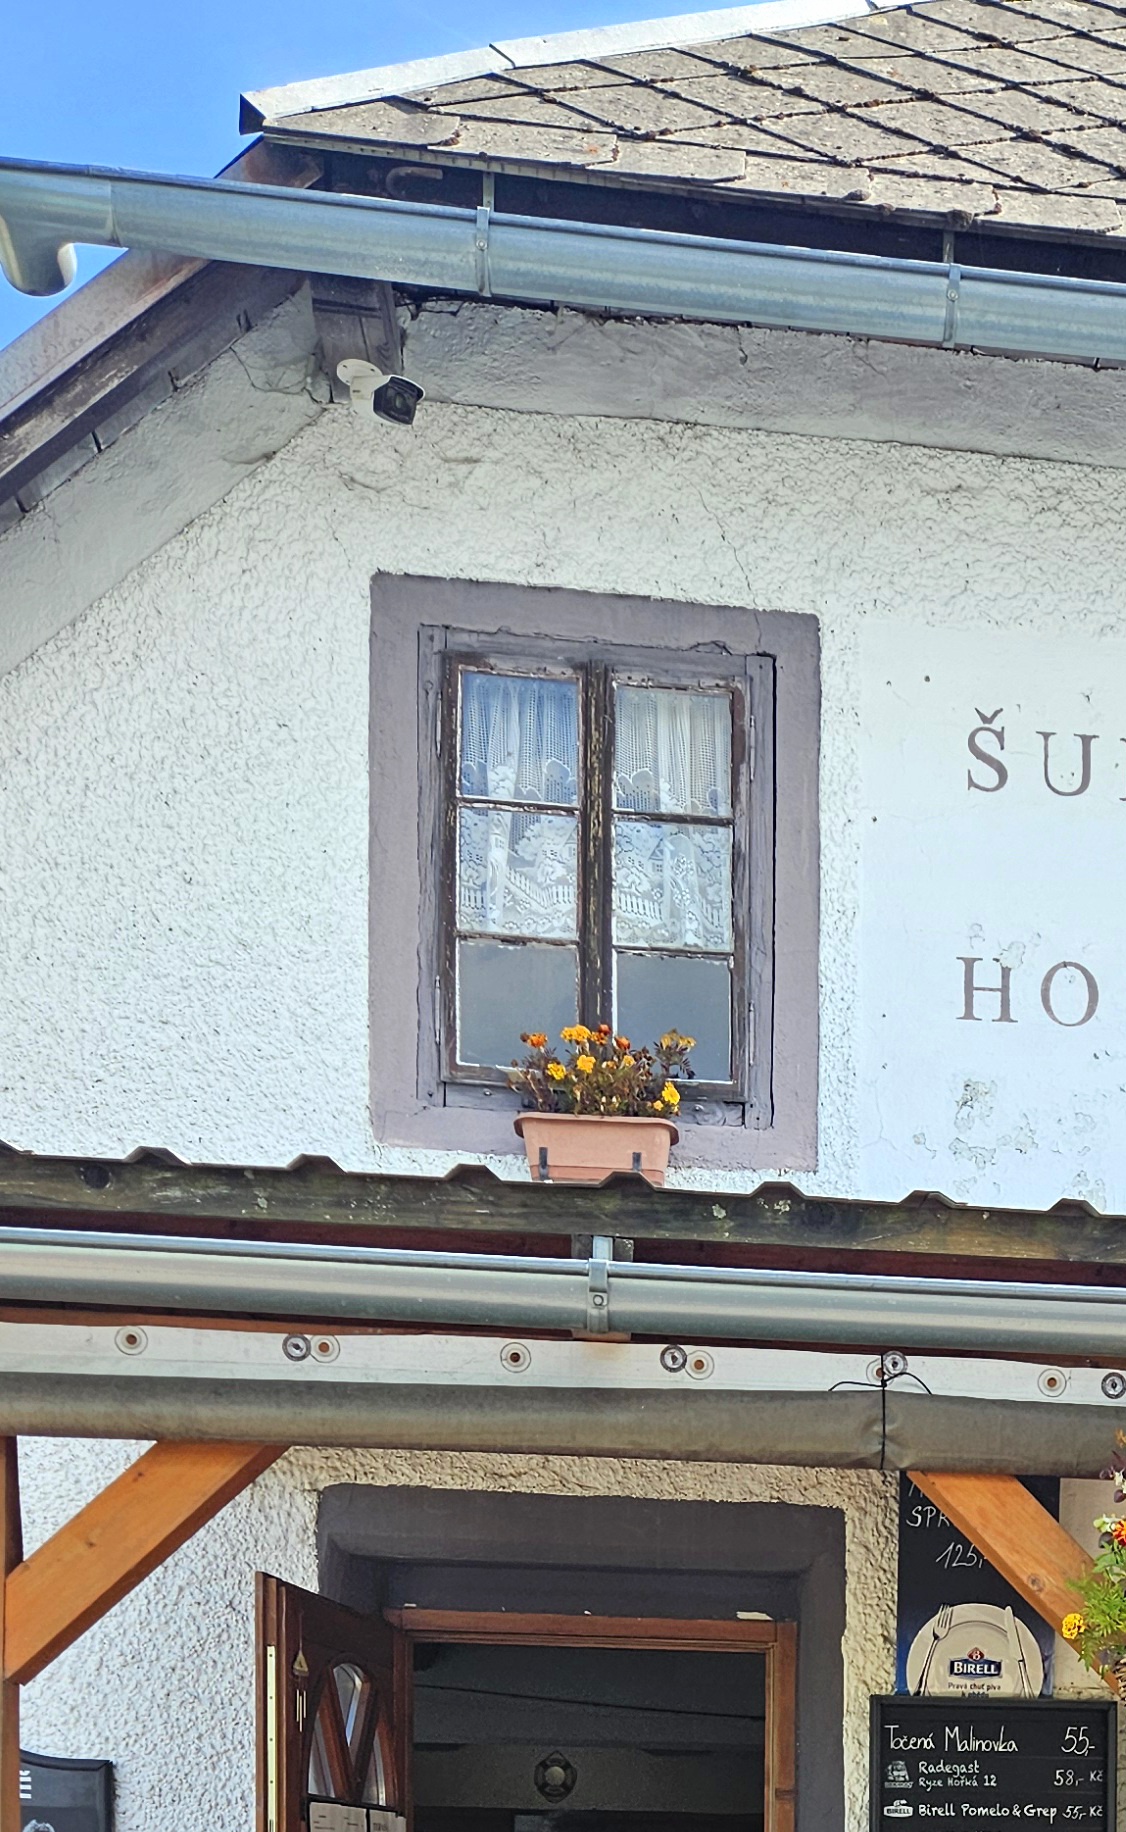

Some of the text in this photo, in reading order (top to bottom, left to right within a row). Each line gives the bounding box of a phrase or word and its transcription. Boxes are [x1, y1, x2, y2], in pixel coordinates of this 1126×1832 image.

[953, 1661, 999, 1675] BIRELL
[944, 1725, 1019, 1752] Malinovka
[918, 1760, 980, 1776] Radegast
[1089, 1770, 1103, 1782] Kč
[918, 1777, 944, 1792] Ryze
[947, 1773, 979, 1787] Hořká
[983, 1775, 997, 1787] 12
[918, 1803, 956, 1817] Birell
[960, 1804, 1009, 1817] Pomelo
[1023, 1804, 1057, 1824] Grep
[1089, 1806, 1103, 1817] Kč
